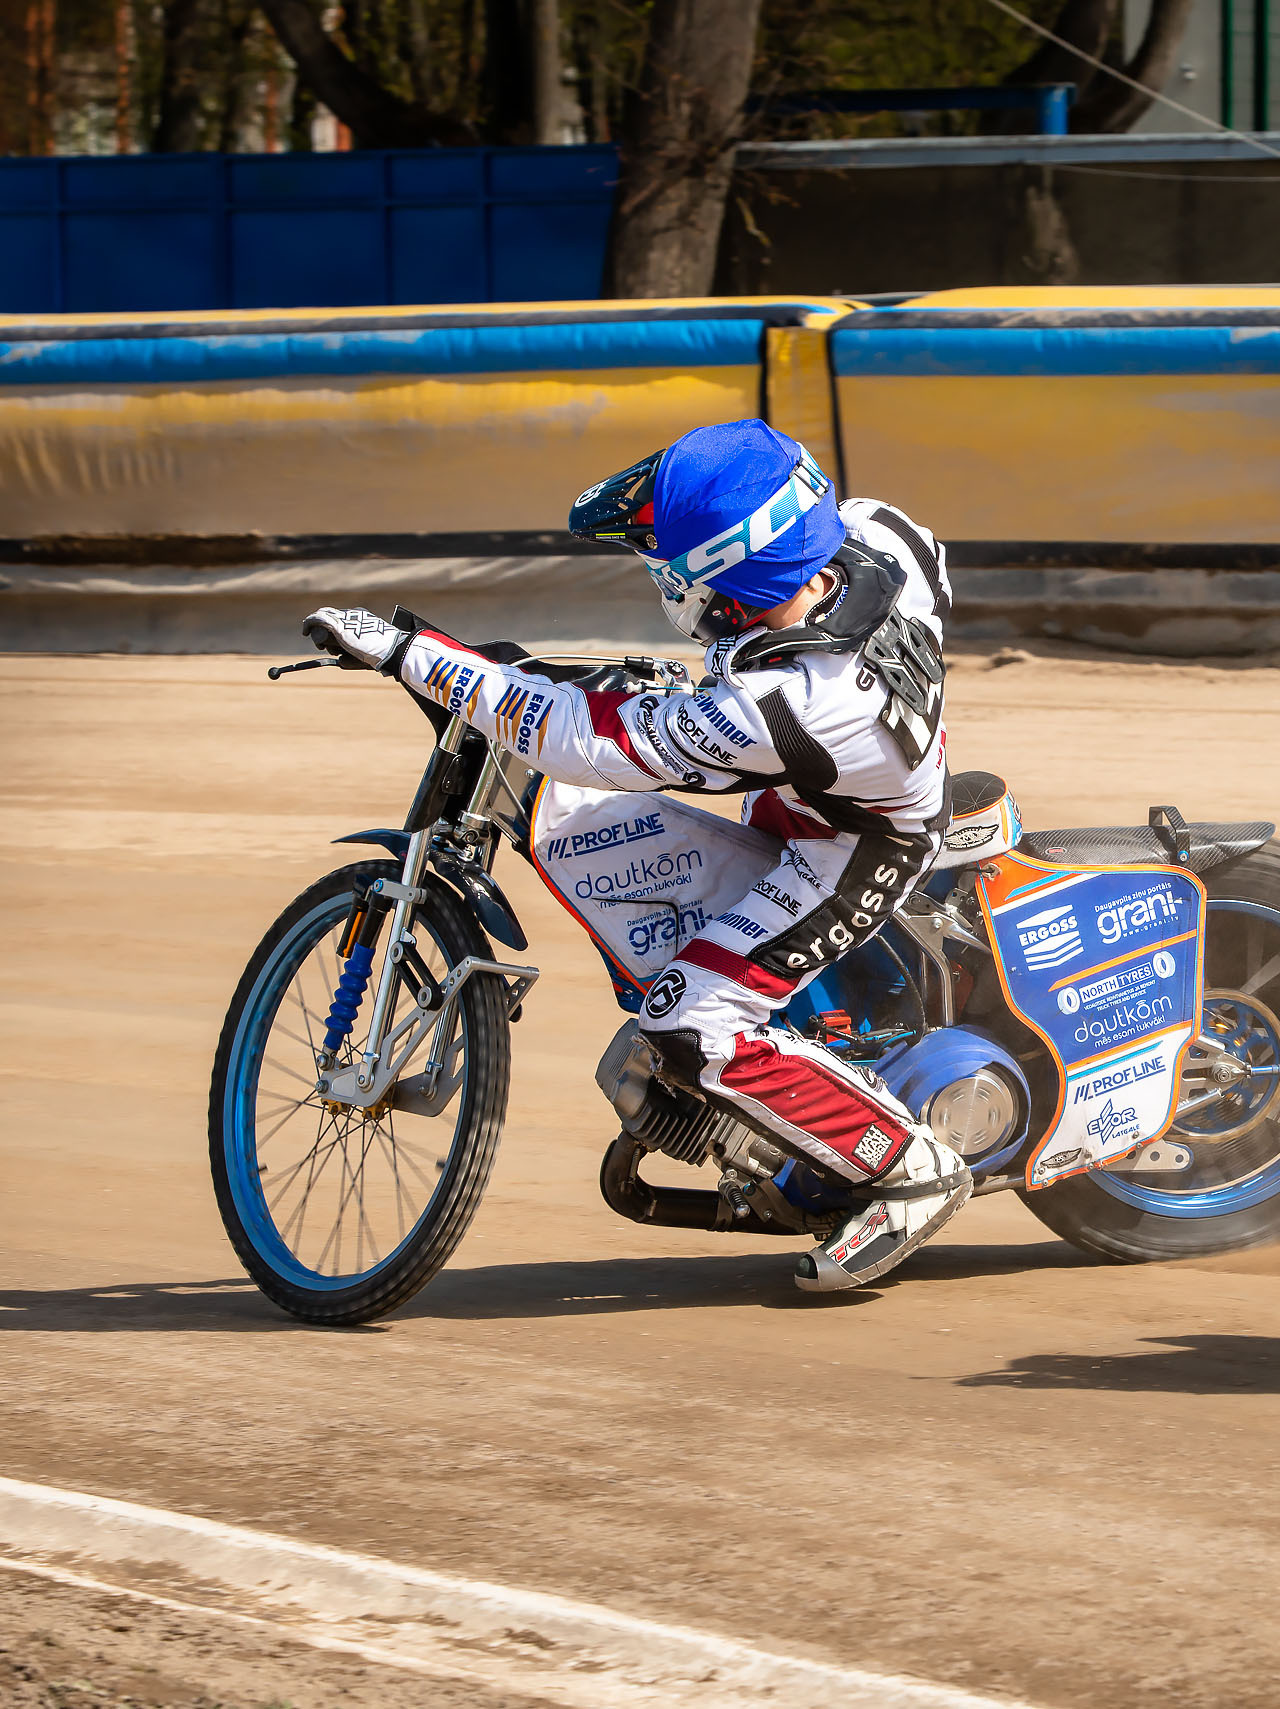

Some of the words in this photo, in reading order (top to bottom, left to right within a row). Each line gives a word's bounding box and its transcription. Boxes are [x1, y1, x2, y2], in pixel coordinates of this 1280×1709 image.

[518, 693, 546, 755] ERGOSS
[571, 813, 665, 851] PROFLINE
[755, 879, 802, 914] ROFLINE
[1018, 915, 1079, 948] ERGOSS
[1083, 980, 1117, 1000] NORTH
[1118, 966, 1152, 986] TYRES
[1093, 1055, 1166, 1093] PROFLINE
